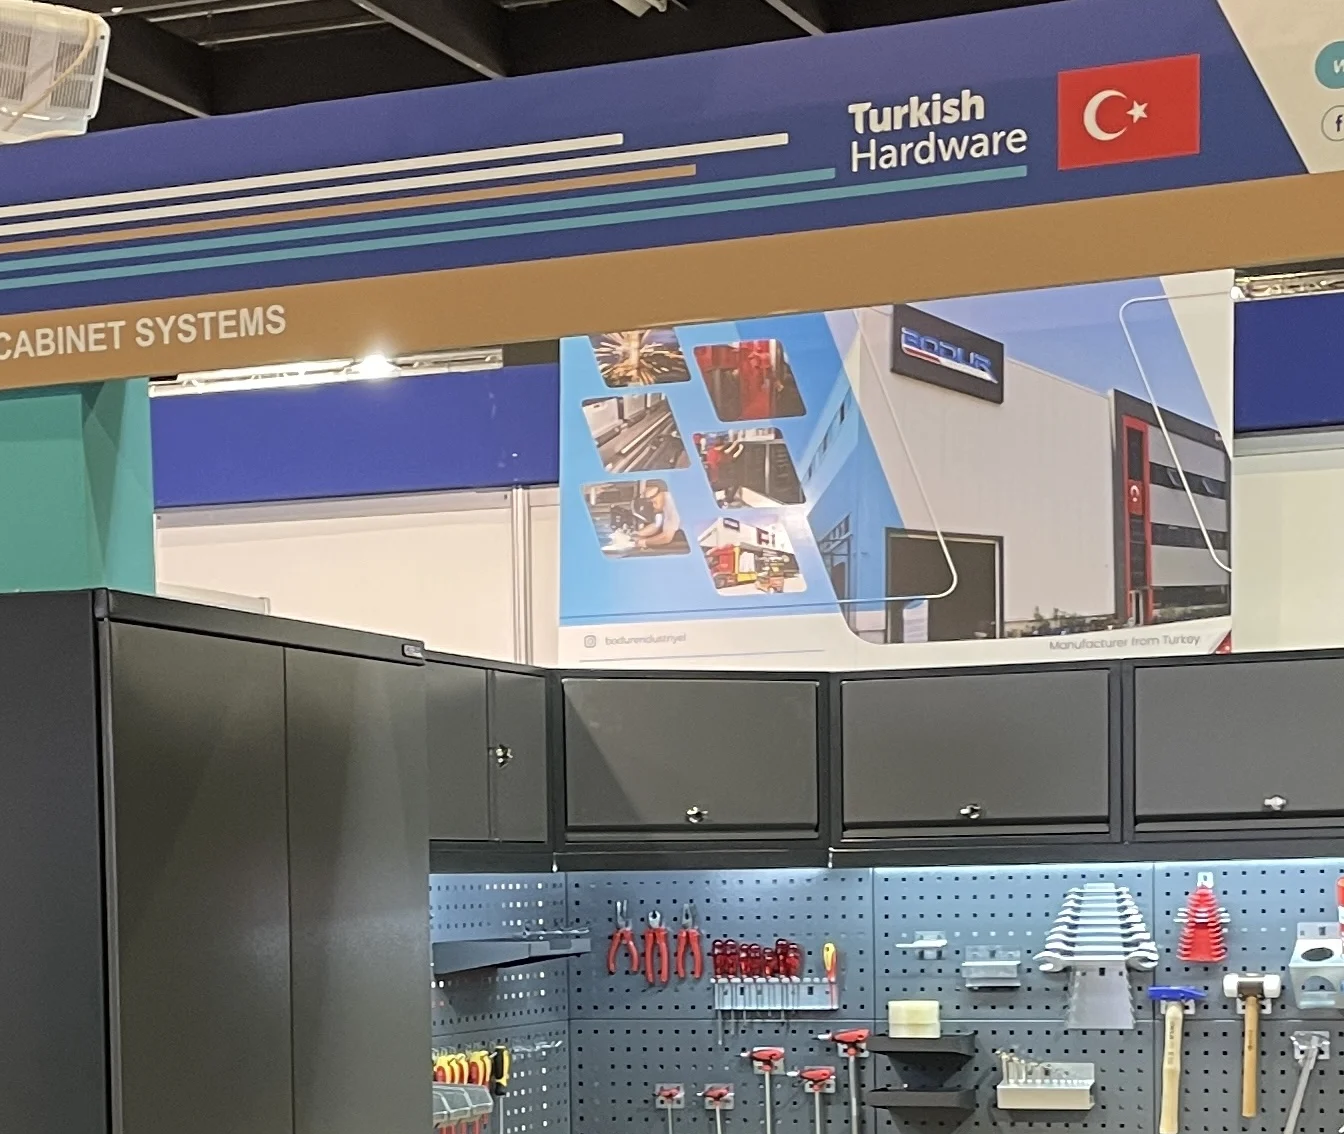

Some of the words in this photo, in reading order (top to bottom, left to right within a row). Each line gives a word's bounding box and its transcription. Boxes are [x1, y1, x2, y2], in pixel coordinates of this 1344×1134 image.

[847, 89, 985, 135] Turkish
[850, 127, 1028, 173] Hardware
[134, 303, 287, 348] SYSTEMS
[902, 327, 998, 384] BODUR
[1049, 638, 1128, 650] Manufacturer
